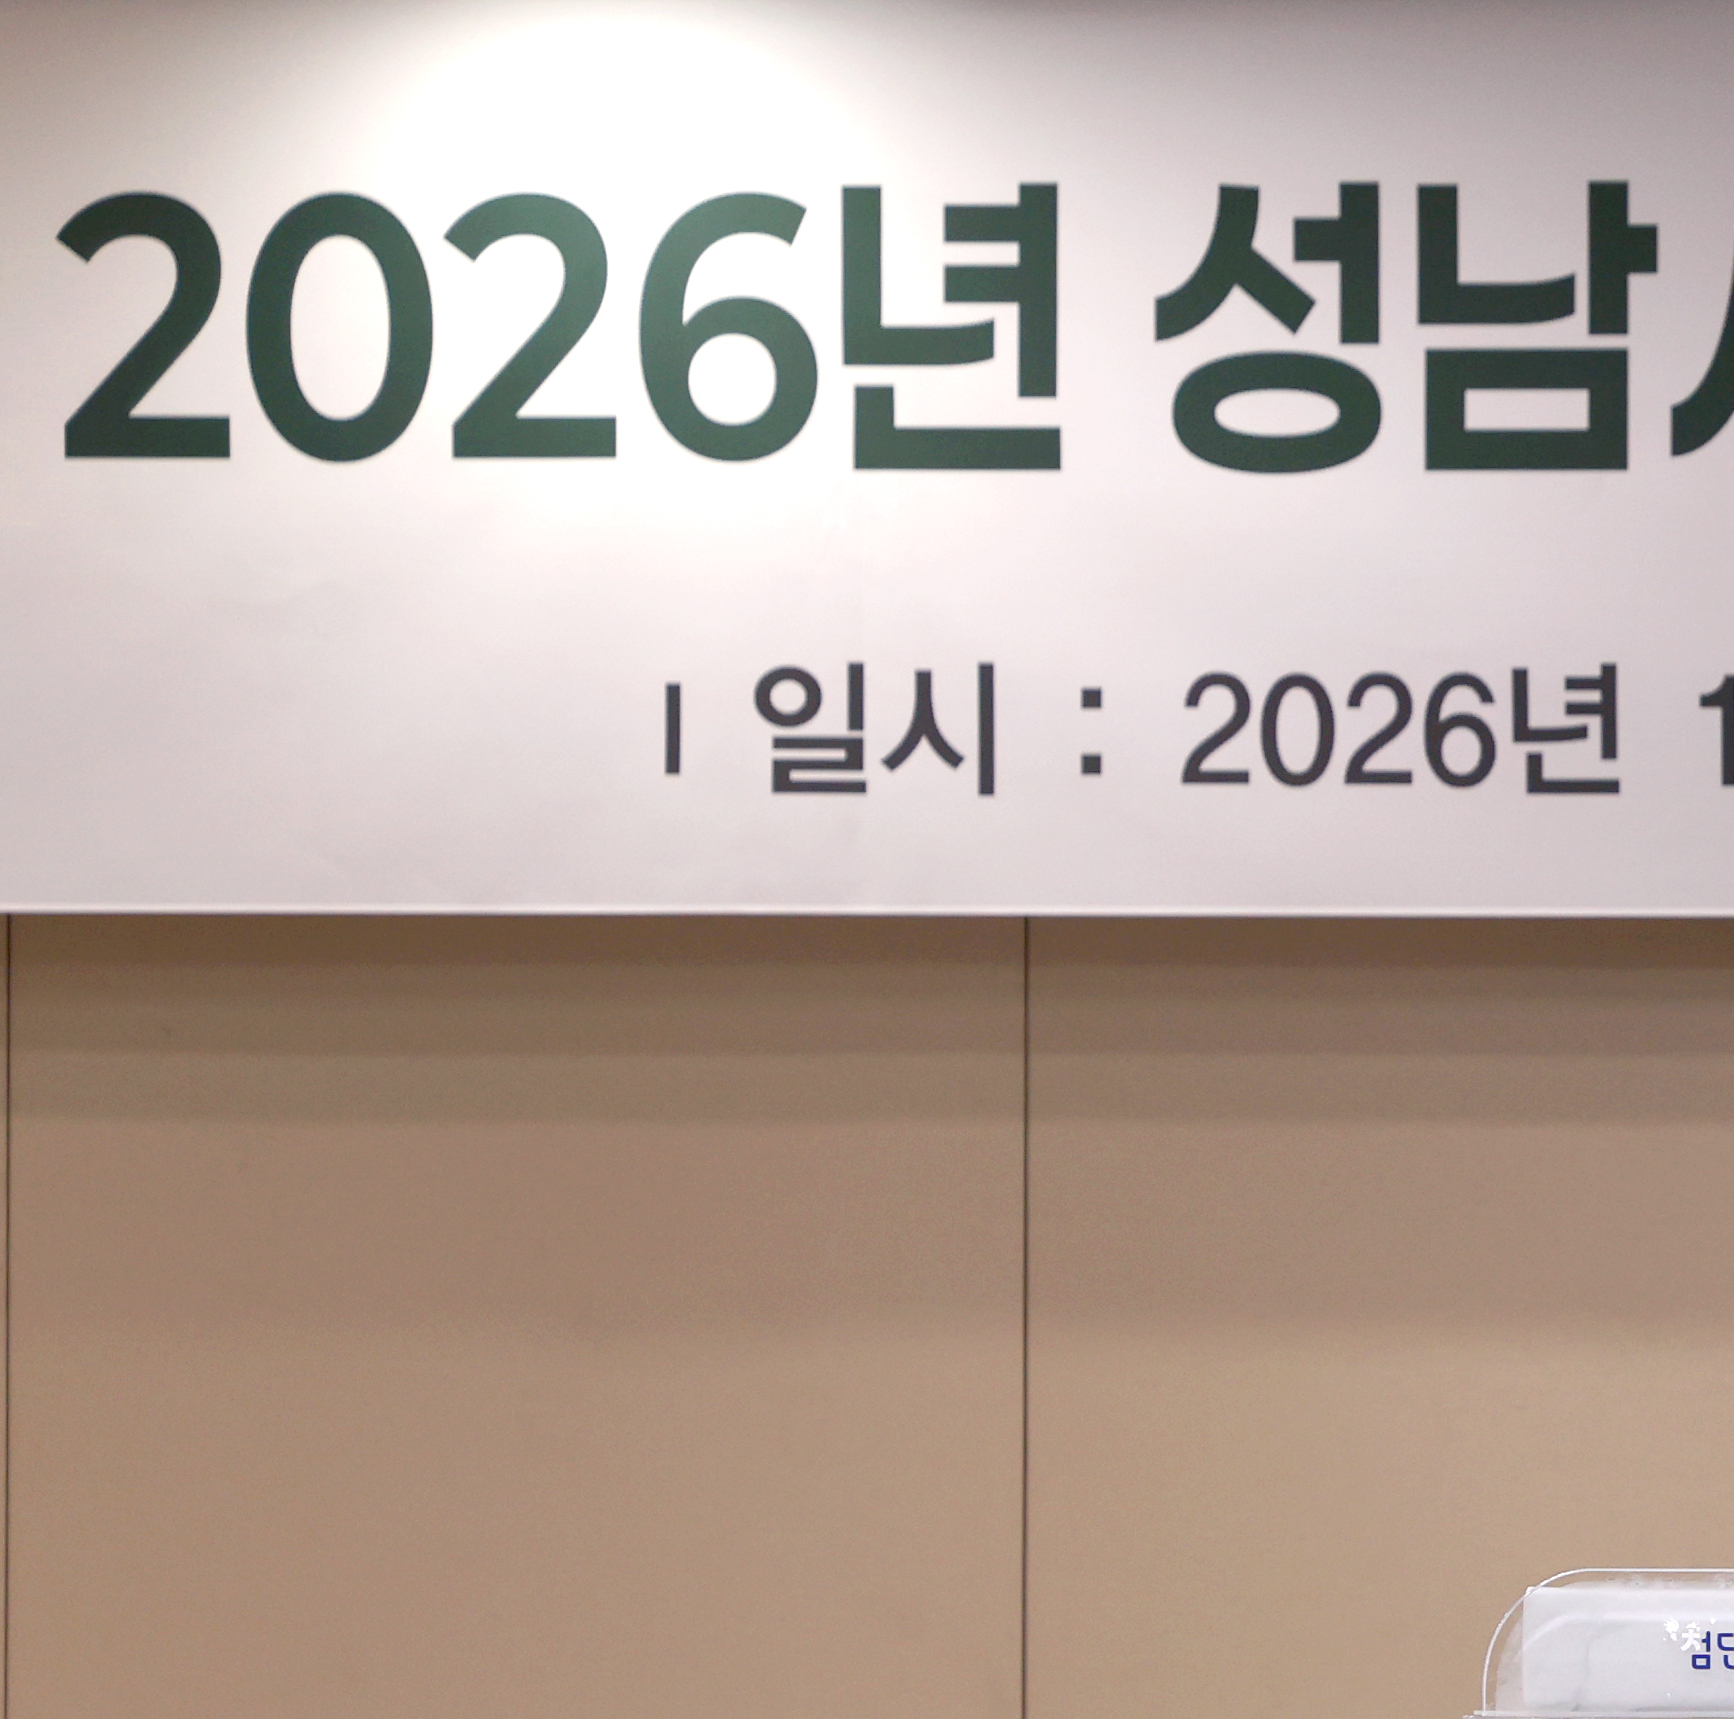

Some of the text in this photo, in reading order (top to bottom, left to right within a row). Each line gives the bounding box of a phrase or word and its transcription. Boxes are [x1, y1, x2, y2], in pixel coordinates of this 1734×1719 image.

[55, 180, 1064, 472] 2026년
[754, 662, 996, 797] 일시
[1181, 662, 1621, 796] 2026년
